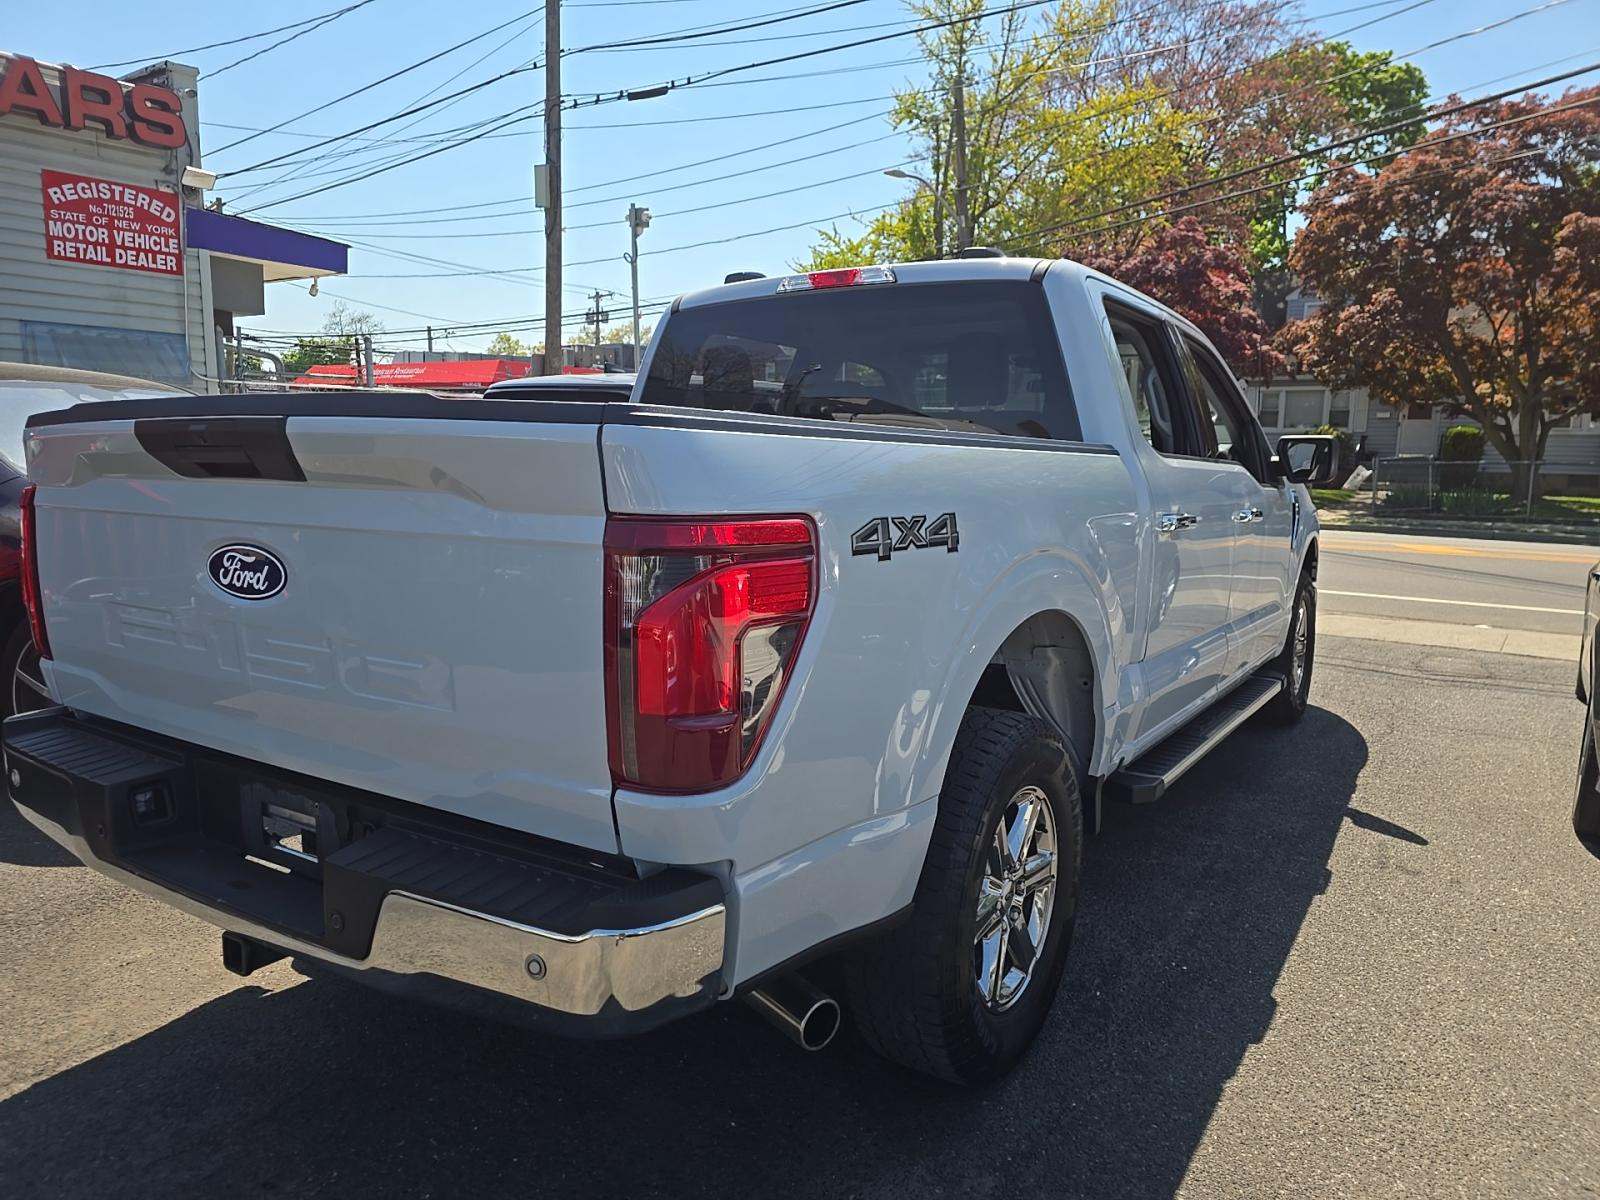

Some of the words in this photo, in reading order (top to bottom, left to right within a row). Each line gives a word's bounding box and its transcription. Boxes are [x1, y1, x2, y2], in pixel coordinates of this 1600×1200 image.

[0, 57, 187, 150] ARS
[48, 182, 176, 222] REGISTERED
[48, 220, 109, 244] MOTOR
[113, 229, 179, 254] VEHICLE
[50, 209, 86, 223] STATE
[92, 215, 109, 226] OF
[114, 219, 141, 231] NEW
[146, 223, 177, 236] YORK
[53, 240, 112, 263] RETAIL
[115, 248, 177, 271] DEALER
[219, 551, 269, 591] Ford
